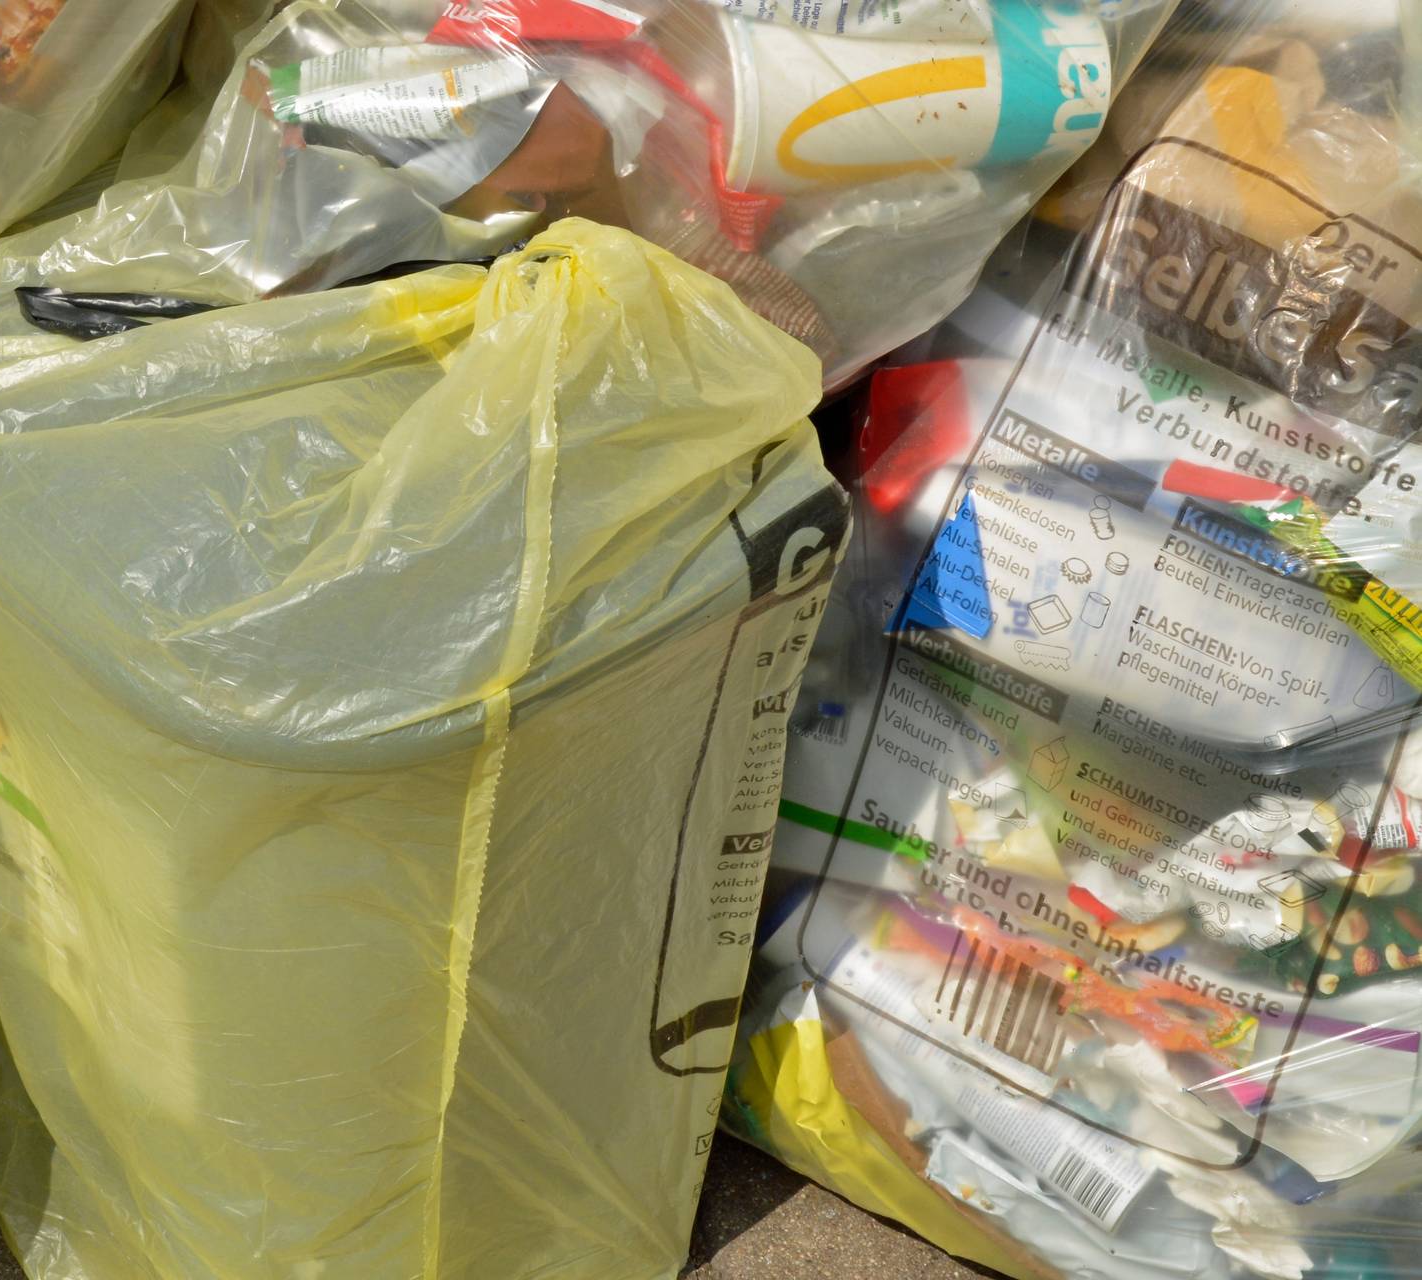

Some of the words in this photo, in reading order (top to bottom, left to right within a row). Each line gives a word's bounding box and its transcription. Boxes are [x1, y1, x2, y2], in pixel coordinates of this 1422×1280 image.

[1045, 309, 1091, 348] für
[1095, 338, 1211, 413] Metalle,
[978, 450, 1055, 500] Konserven
[997, 415, 1100, 483] Metalle
[953, 498, 1040, 554] Verschlüsse
[964, 474, 1077, 543] Getränkedosen
[930, 551, 1015, 602] Alu-Deckel
[940, 525, 1031, 580] Alu-Schalen
[1162, 533, 1235, 580] FOLIEN:
[921, 576, 999, 624] Alu-Folien
[1155, 554, 1210, 596] Beutel,
[1214, 582, 1350, 648] Einwickelfolien
[908, 626, 1054, 715] Verbundstoffe
[1117, 651, 1219, 707] pflegemittel
[1133, 604, 1238, 666] FLASCHEN:
[1239, 651, 1274, 681] Von
[883, 704, 955, 755] Vakuum-
[887, 681, 1002, 758] Milchkartons,
[895, 656, 979, 709] Getränke-
[981, 702, 1020, 732] und
[874, 733, 994, 809] verpackungen
[1096, 696, 1176, 747] BECHER:
[1180, 735, 1304, 800] Milchprodukte,
[1178, 759, 1208, 788] etc.
[1069, 787, 1103, 814] und
[1105, 802, 1237, 876] Gemüseschalen
[1075, 761, 1229, 846] SCHAUMSTOFFE:
[1055, 827, 1172, 898] Verpackungen
[1062, 809, 1096, 835] und
[1097, 824, 1155, 864] andere
[1156, 854, 1267, 911] geschäumte
[859, 798, 952, 869] Sauber
[955, 856, 1013, 900] und
[1015, 890, 1089, 941] ohne
[1094, 924, 1288, 1019] Inhaltsreste
